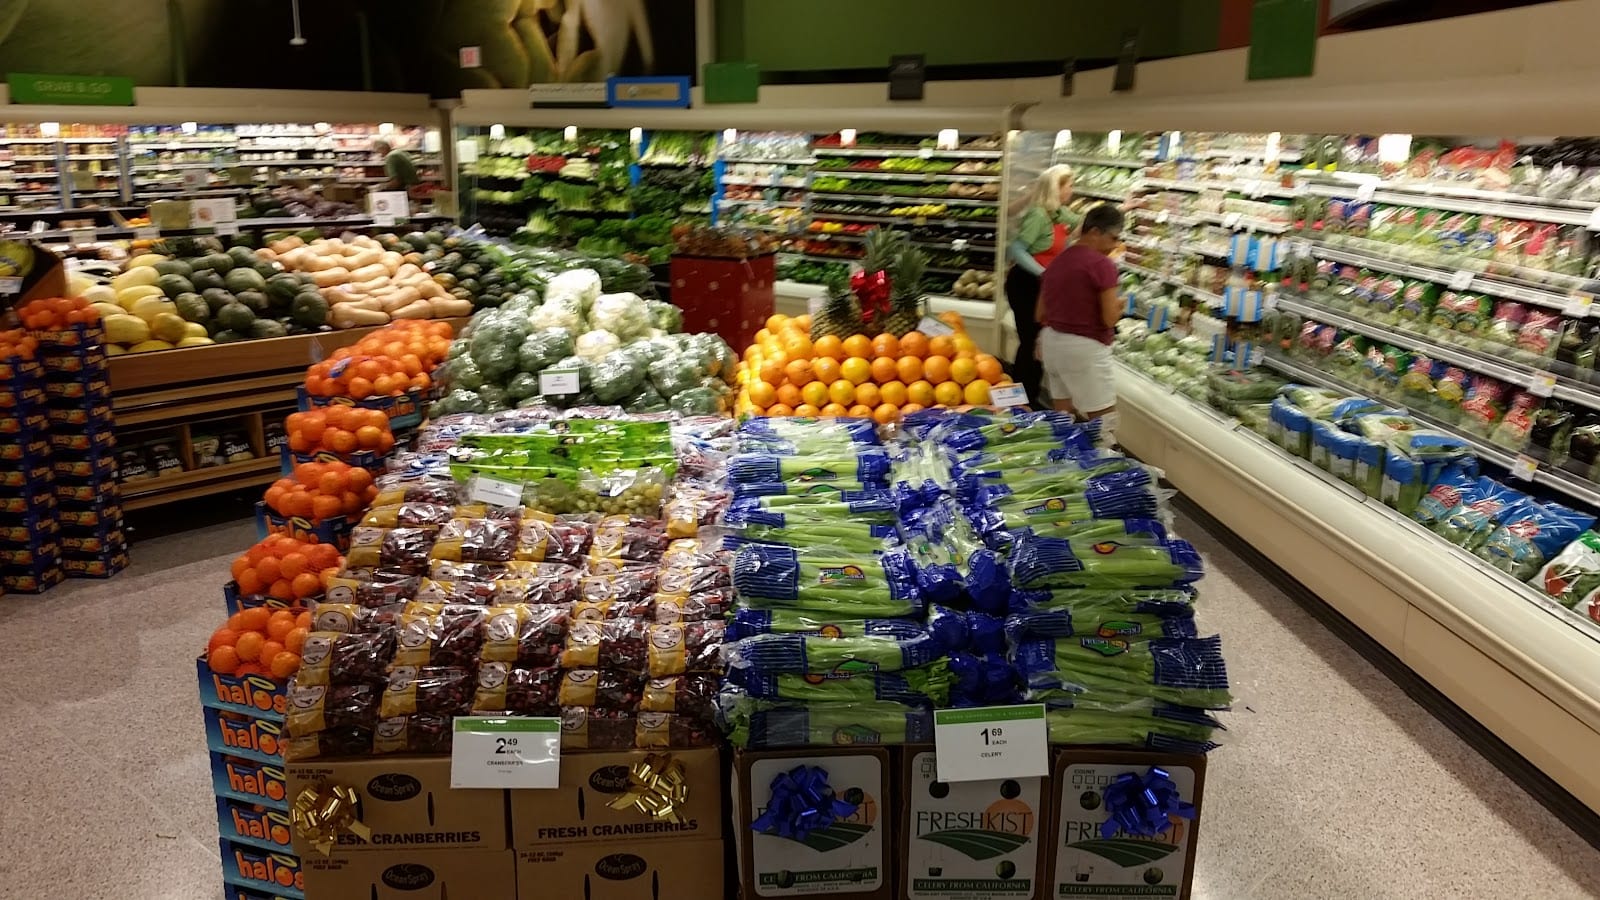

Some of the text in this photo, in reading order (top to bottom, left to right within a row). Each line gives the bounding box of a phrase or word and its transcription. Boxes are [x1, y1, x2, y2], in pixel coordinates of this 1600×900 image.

[212, 673, 287, 714] halos
[495, 738, 507, 754] 2
[507, 738, 518, 746] 49
[980, 728, 989, 745] 1
[991, 728, 1003, 736] 69
[226, 762, 287, 801] halo
[231, 806, 291, 846] halo
[538, 819, 698, 840] FRESH CRANBERRIES
[917, 811, 1033, 835] FRESHKIST
[371, 830, 481, 846] CRANBERRIES
[235, 849, 304, 889] halos
[917, 880, 1026, 890] CELERY FROM CALIFORNIA
[1063, 885, 1173, 895] CELERY FROM CALIFORNIA
